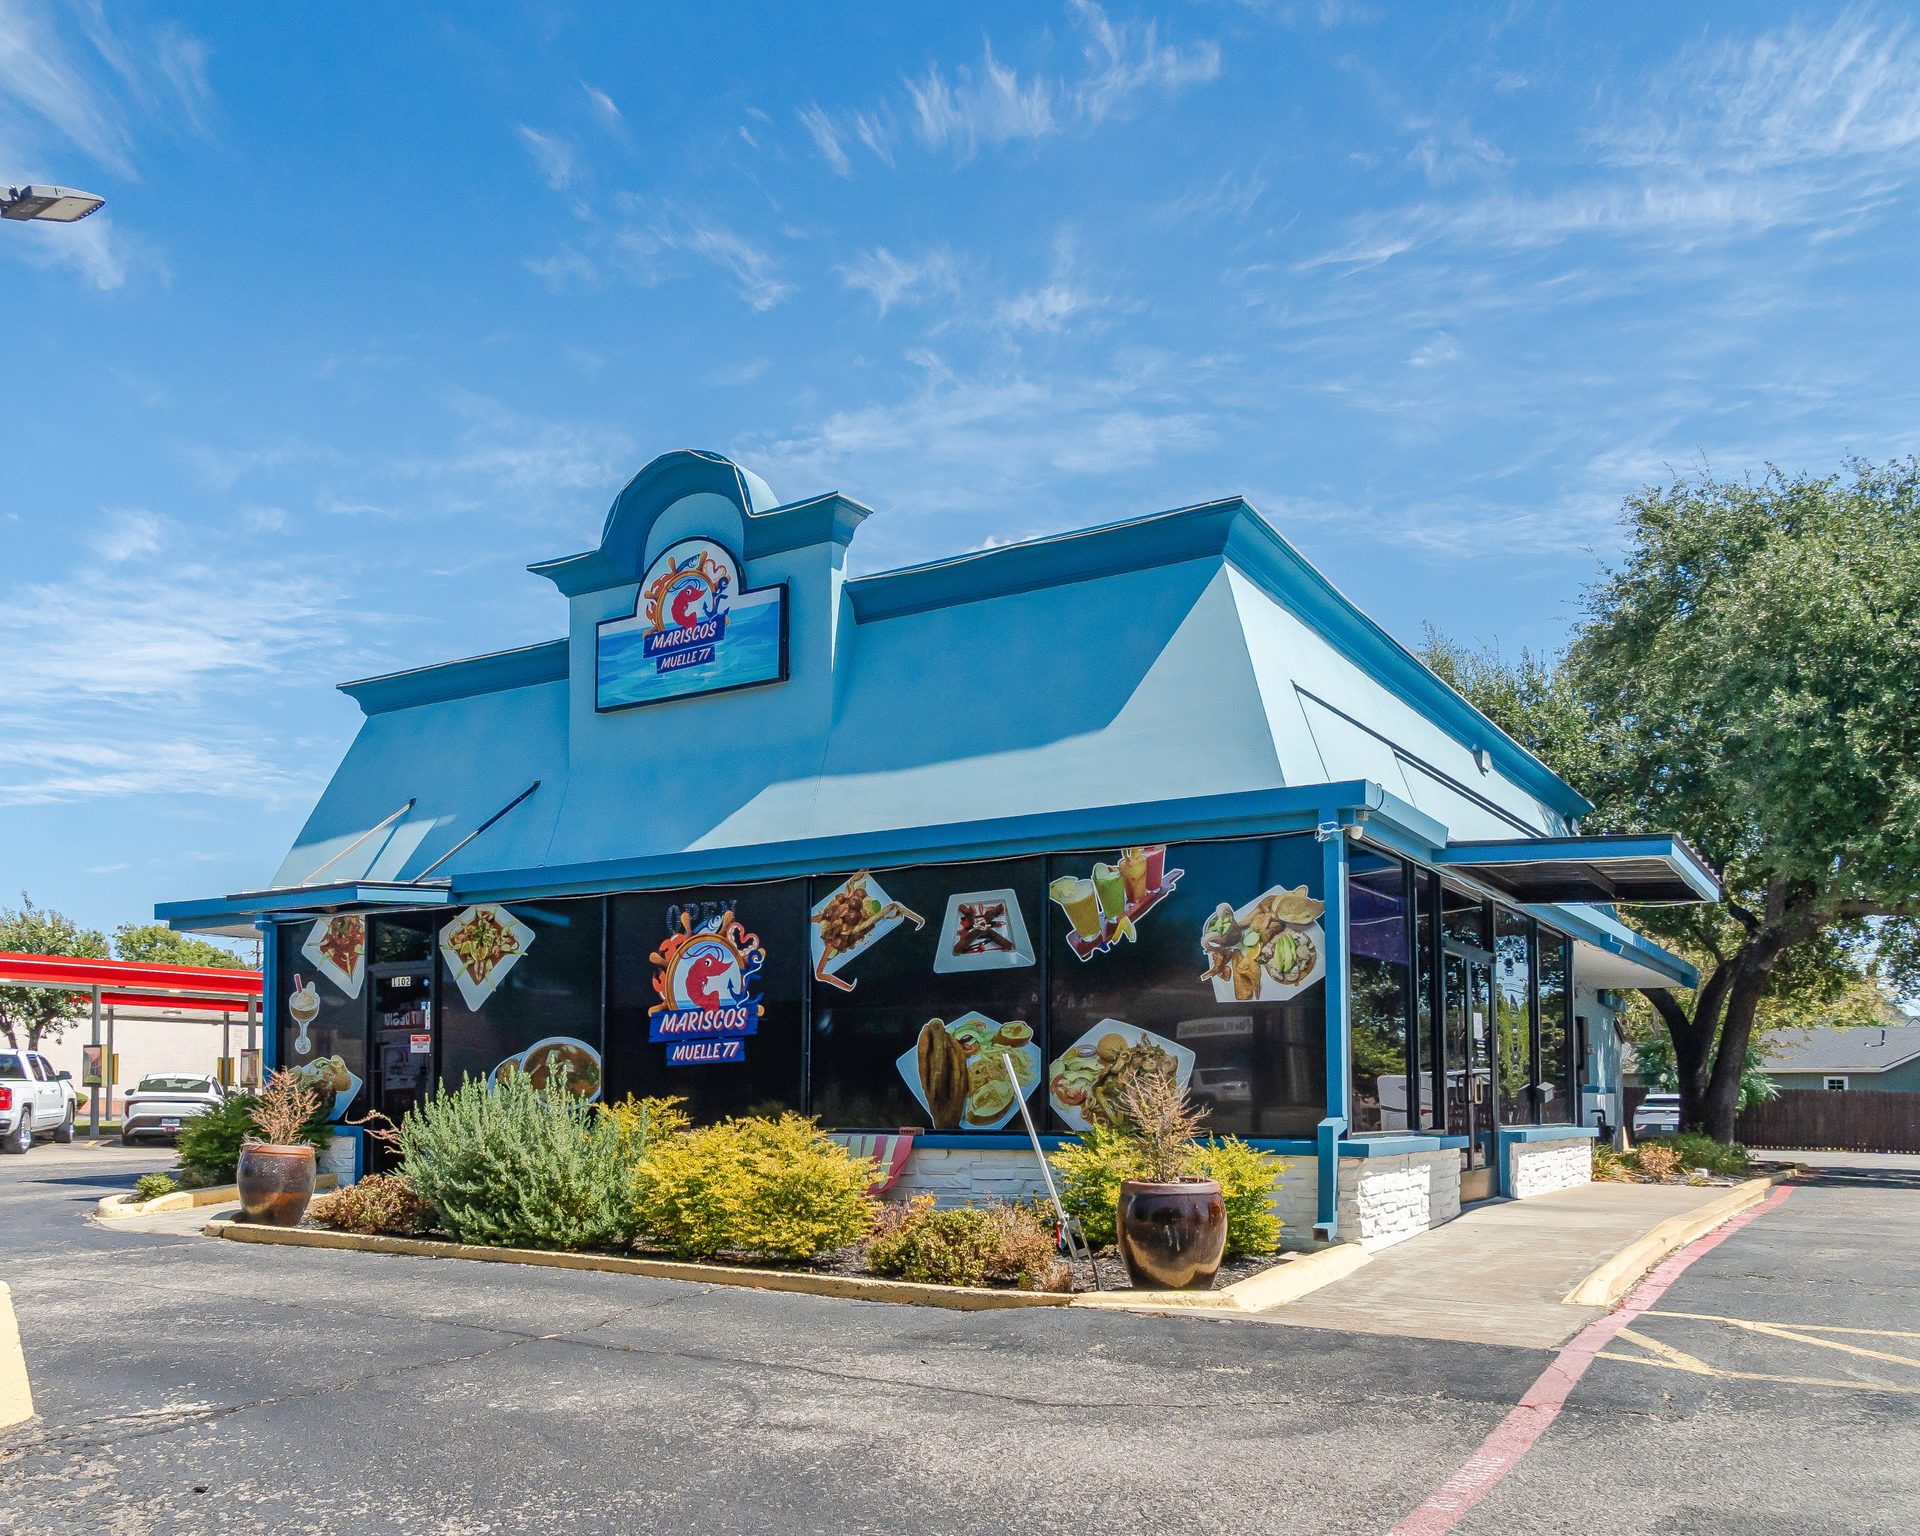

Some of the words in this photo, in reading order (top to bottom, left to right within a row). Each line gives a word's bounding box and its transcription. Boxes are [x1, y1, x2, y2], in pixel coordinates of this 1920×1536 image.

[651, 622, 716, 650] MARISCOS
[660, 650, 697, 669] MUELLE
[699, 648, 711, 660] 77
[393, 977, 410, 986] 1102
[659, 1007, 748, 1034] MARISCOS
[672, 1043, 720, 1061] MUELLE
[720, 1042, 739, 1058] 77
